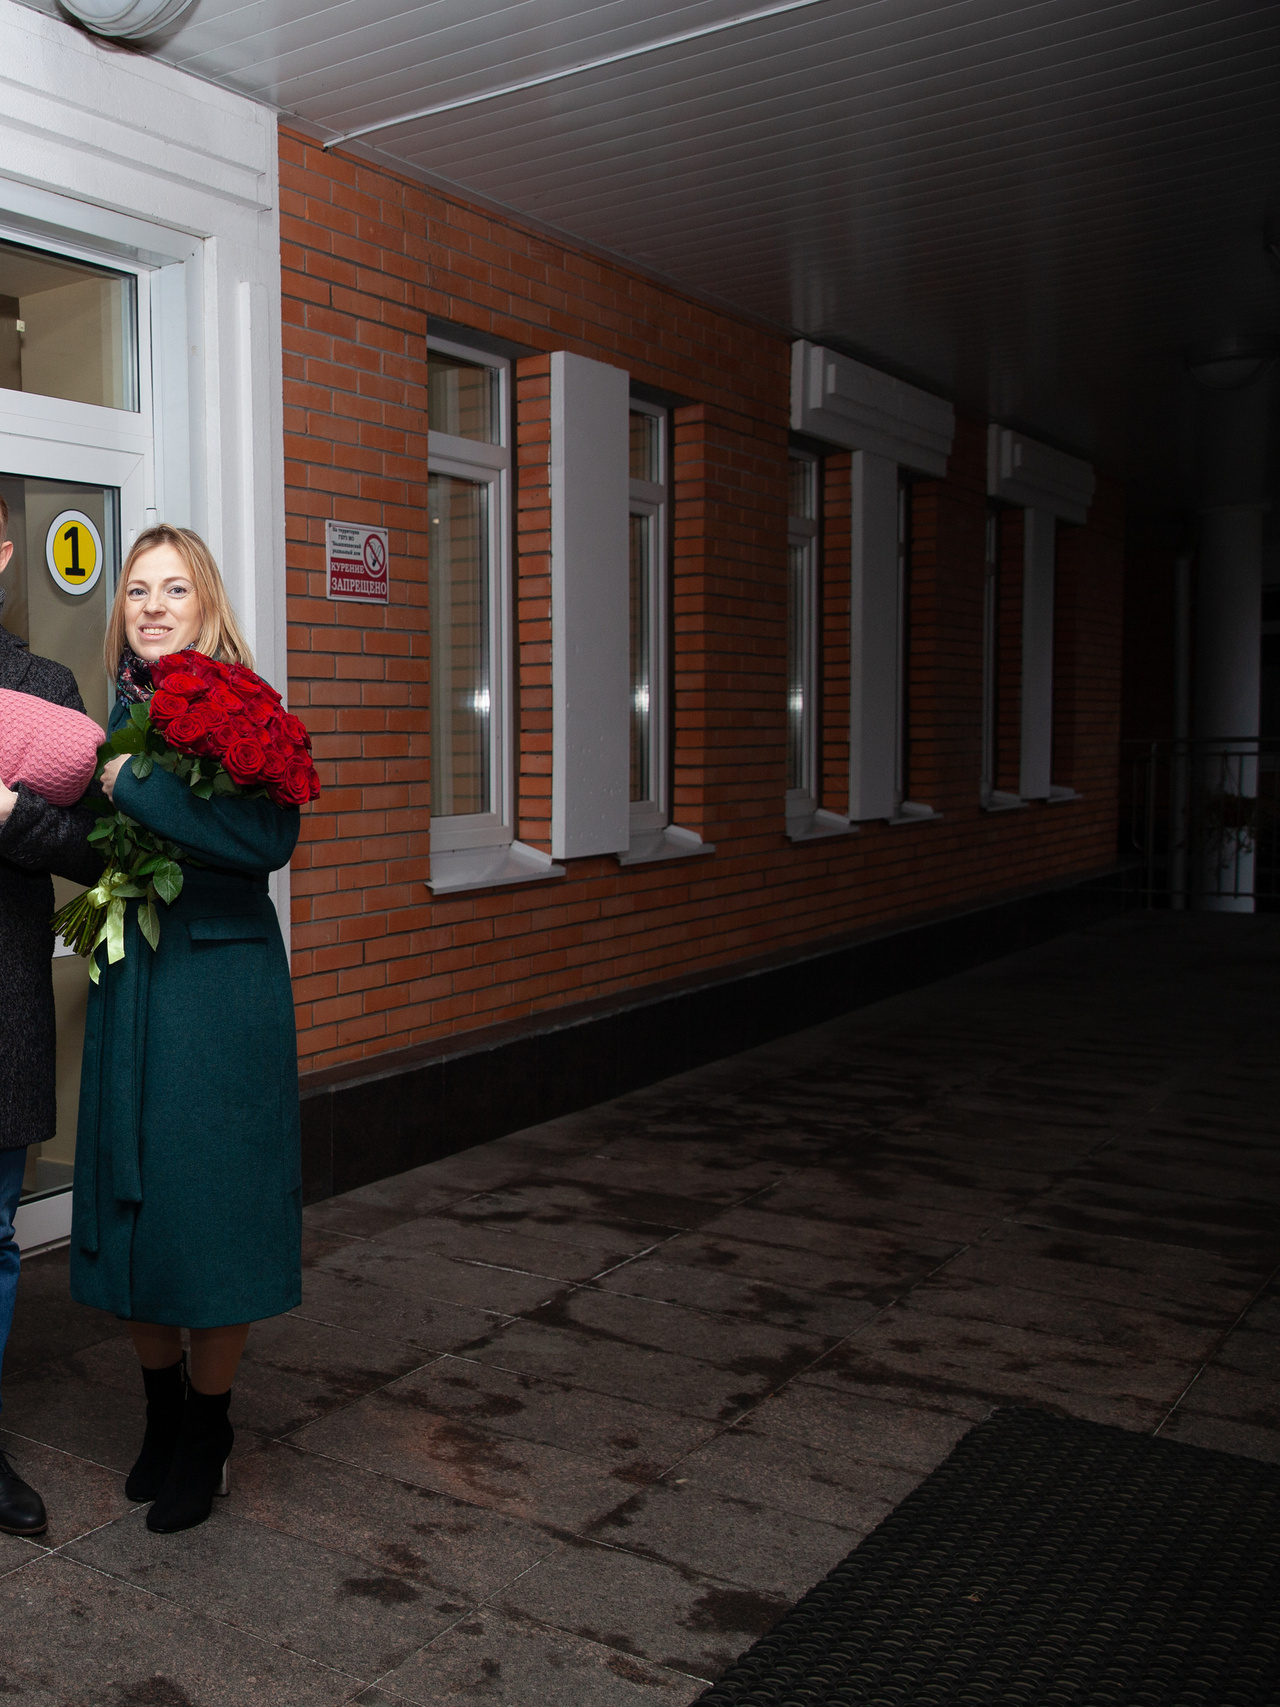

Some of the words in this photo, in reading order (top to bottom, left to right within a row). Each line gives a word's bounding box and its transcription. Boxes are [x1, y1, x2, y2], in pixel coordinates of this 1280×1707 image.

[64, 526, 86, 576] 1
[331, 562, 365, 574] КУРЕНИЕ
[332, 578, 386, 595] ЗАПРЕЩЕНО
